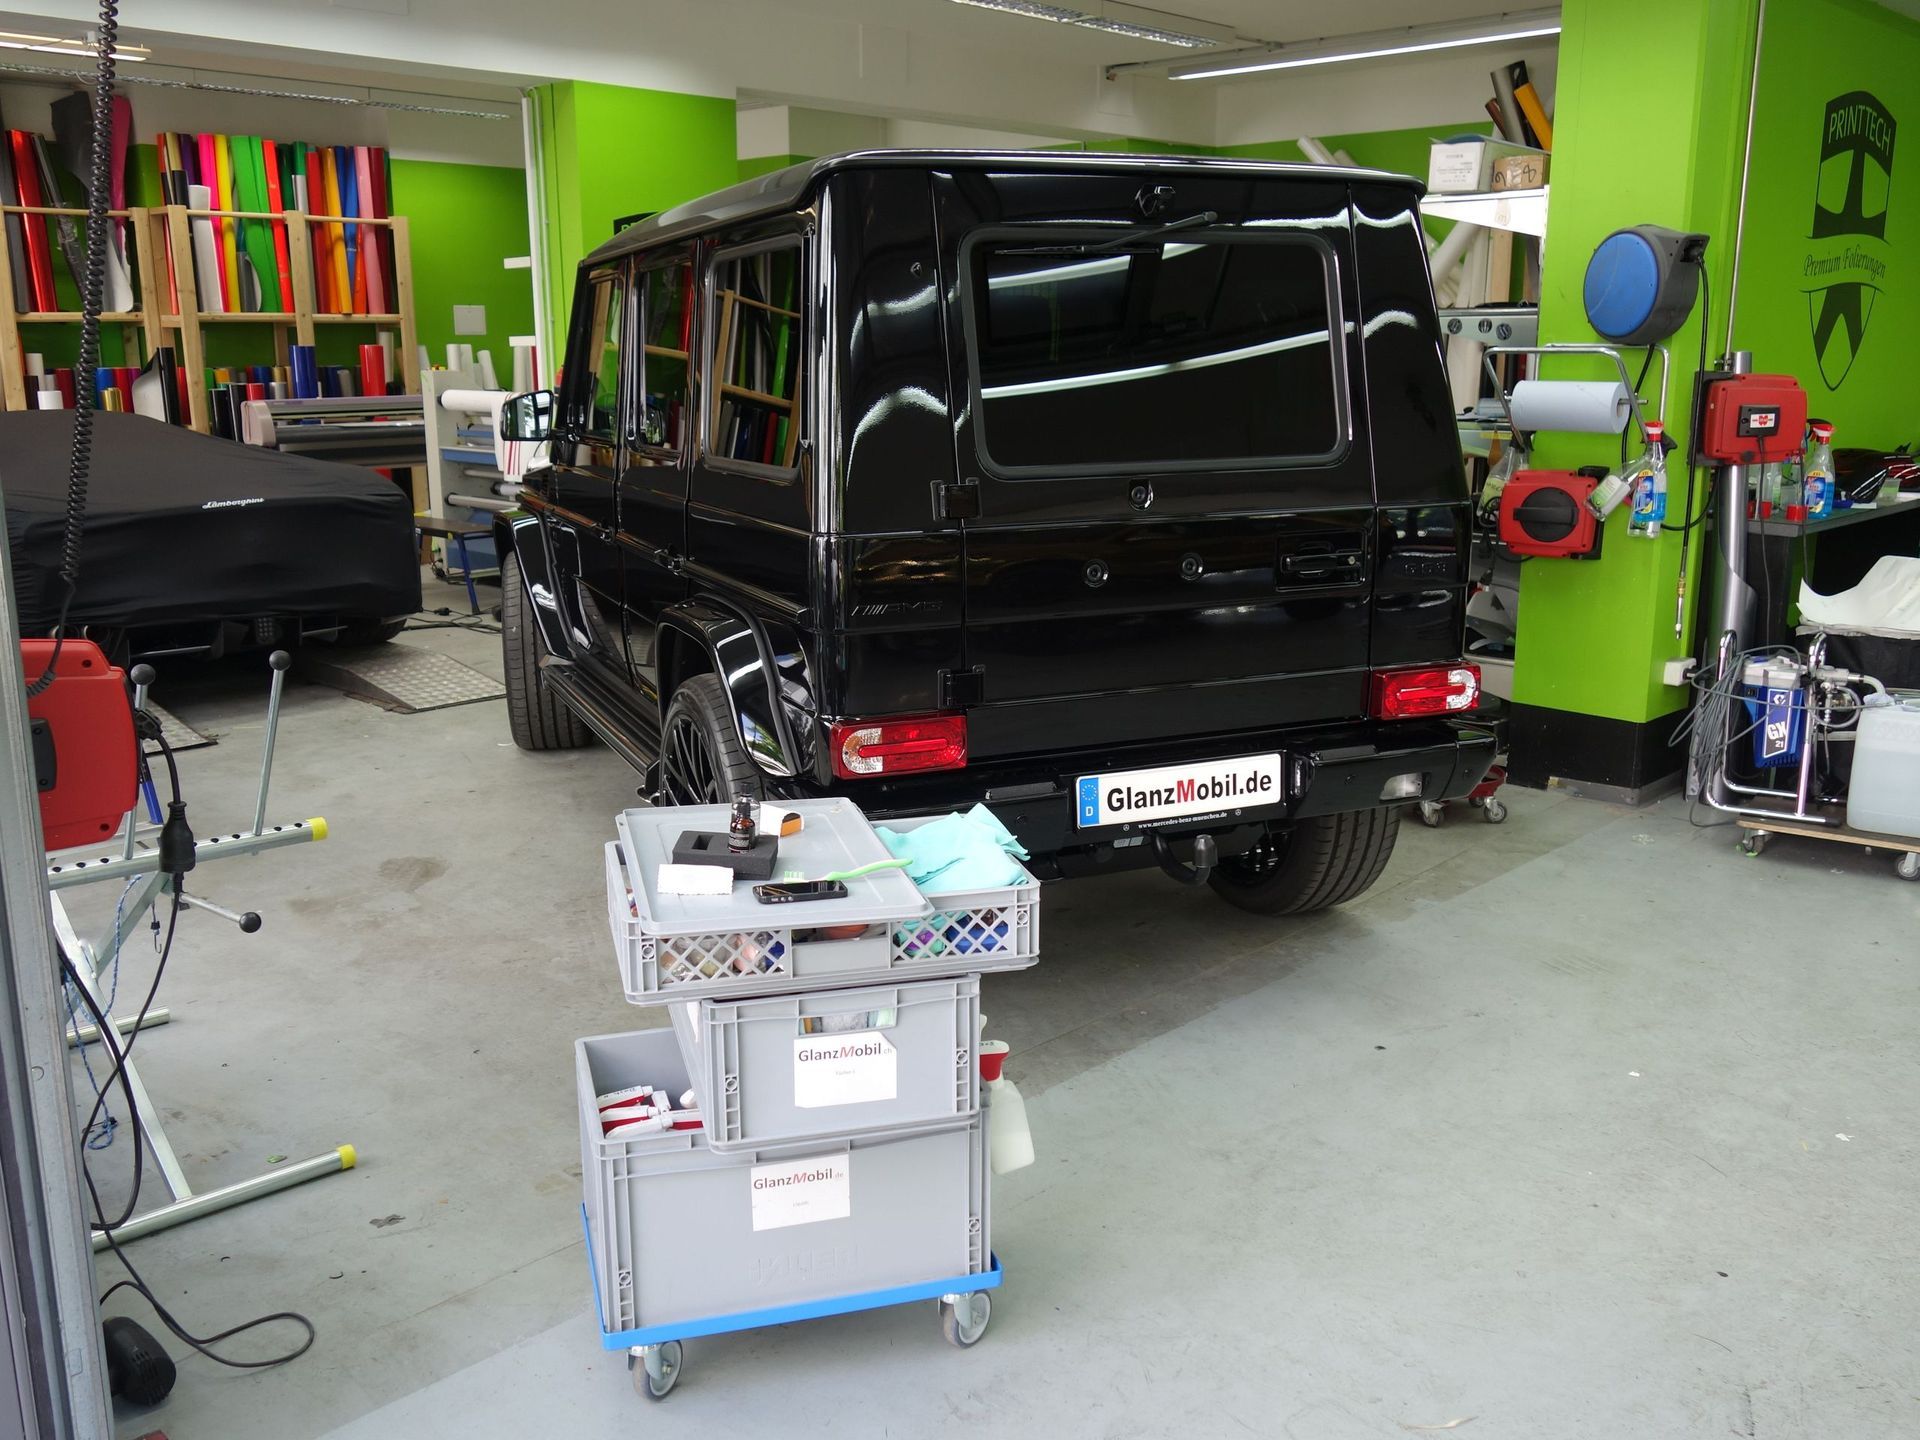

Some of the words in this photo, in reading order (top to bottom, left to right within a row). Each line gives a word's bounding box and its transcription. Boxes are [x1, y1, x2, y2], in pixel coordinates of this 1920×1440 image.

[1803, 251, 1841, 277] Premium
[202, 497, 264, 509] Lamborghini
[1767, 721, 1787, 740] GX
[1775, 740, 1784, 748] 21
[1107, 770, 1273, 812] GlanzMobil.de
[1085, 806, 1094, 817] D
[1137, 811, 1228, 829] www.mercedes-benz-muenchen.de
